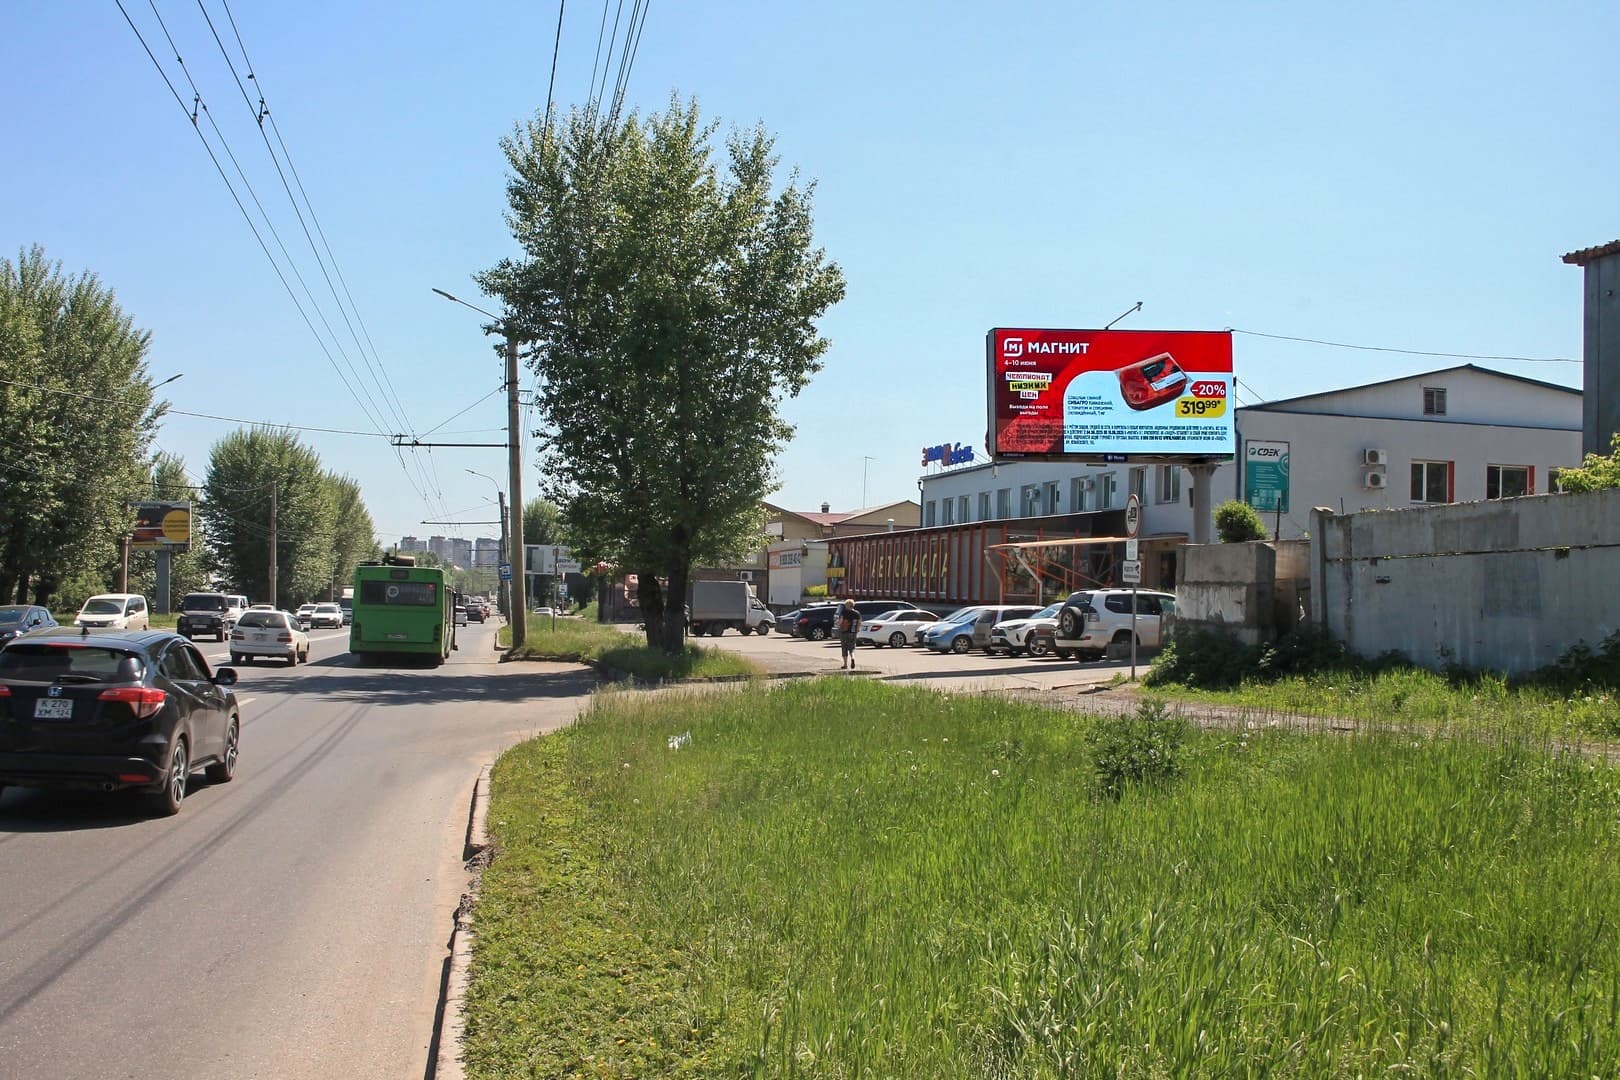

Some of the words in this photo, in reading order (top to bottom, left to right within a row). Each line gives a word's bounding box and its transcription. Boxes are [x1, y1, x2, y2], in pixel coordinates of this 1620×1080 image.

[1028, 342, 1090, 354] МАГНИТ
[1006, 373, 1050, 382] ЧЕМПИОНАТ
[1011, 382, 1047, 390] НИЗКИХ
[1257, 448, 1280, 457] CDEK
